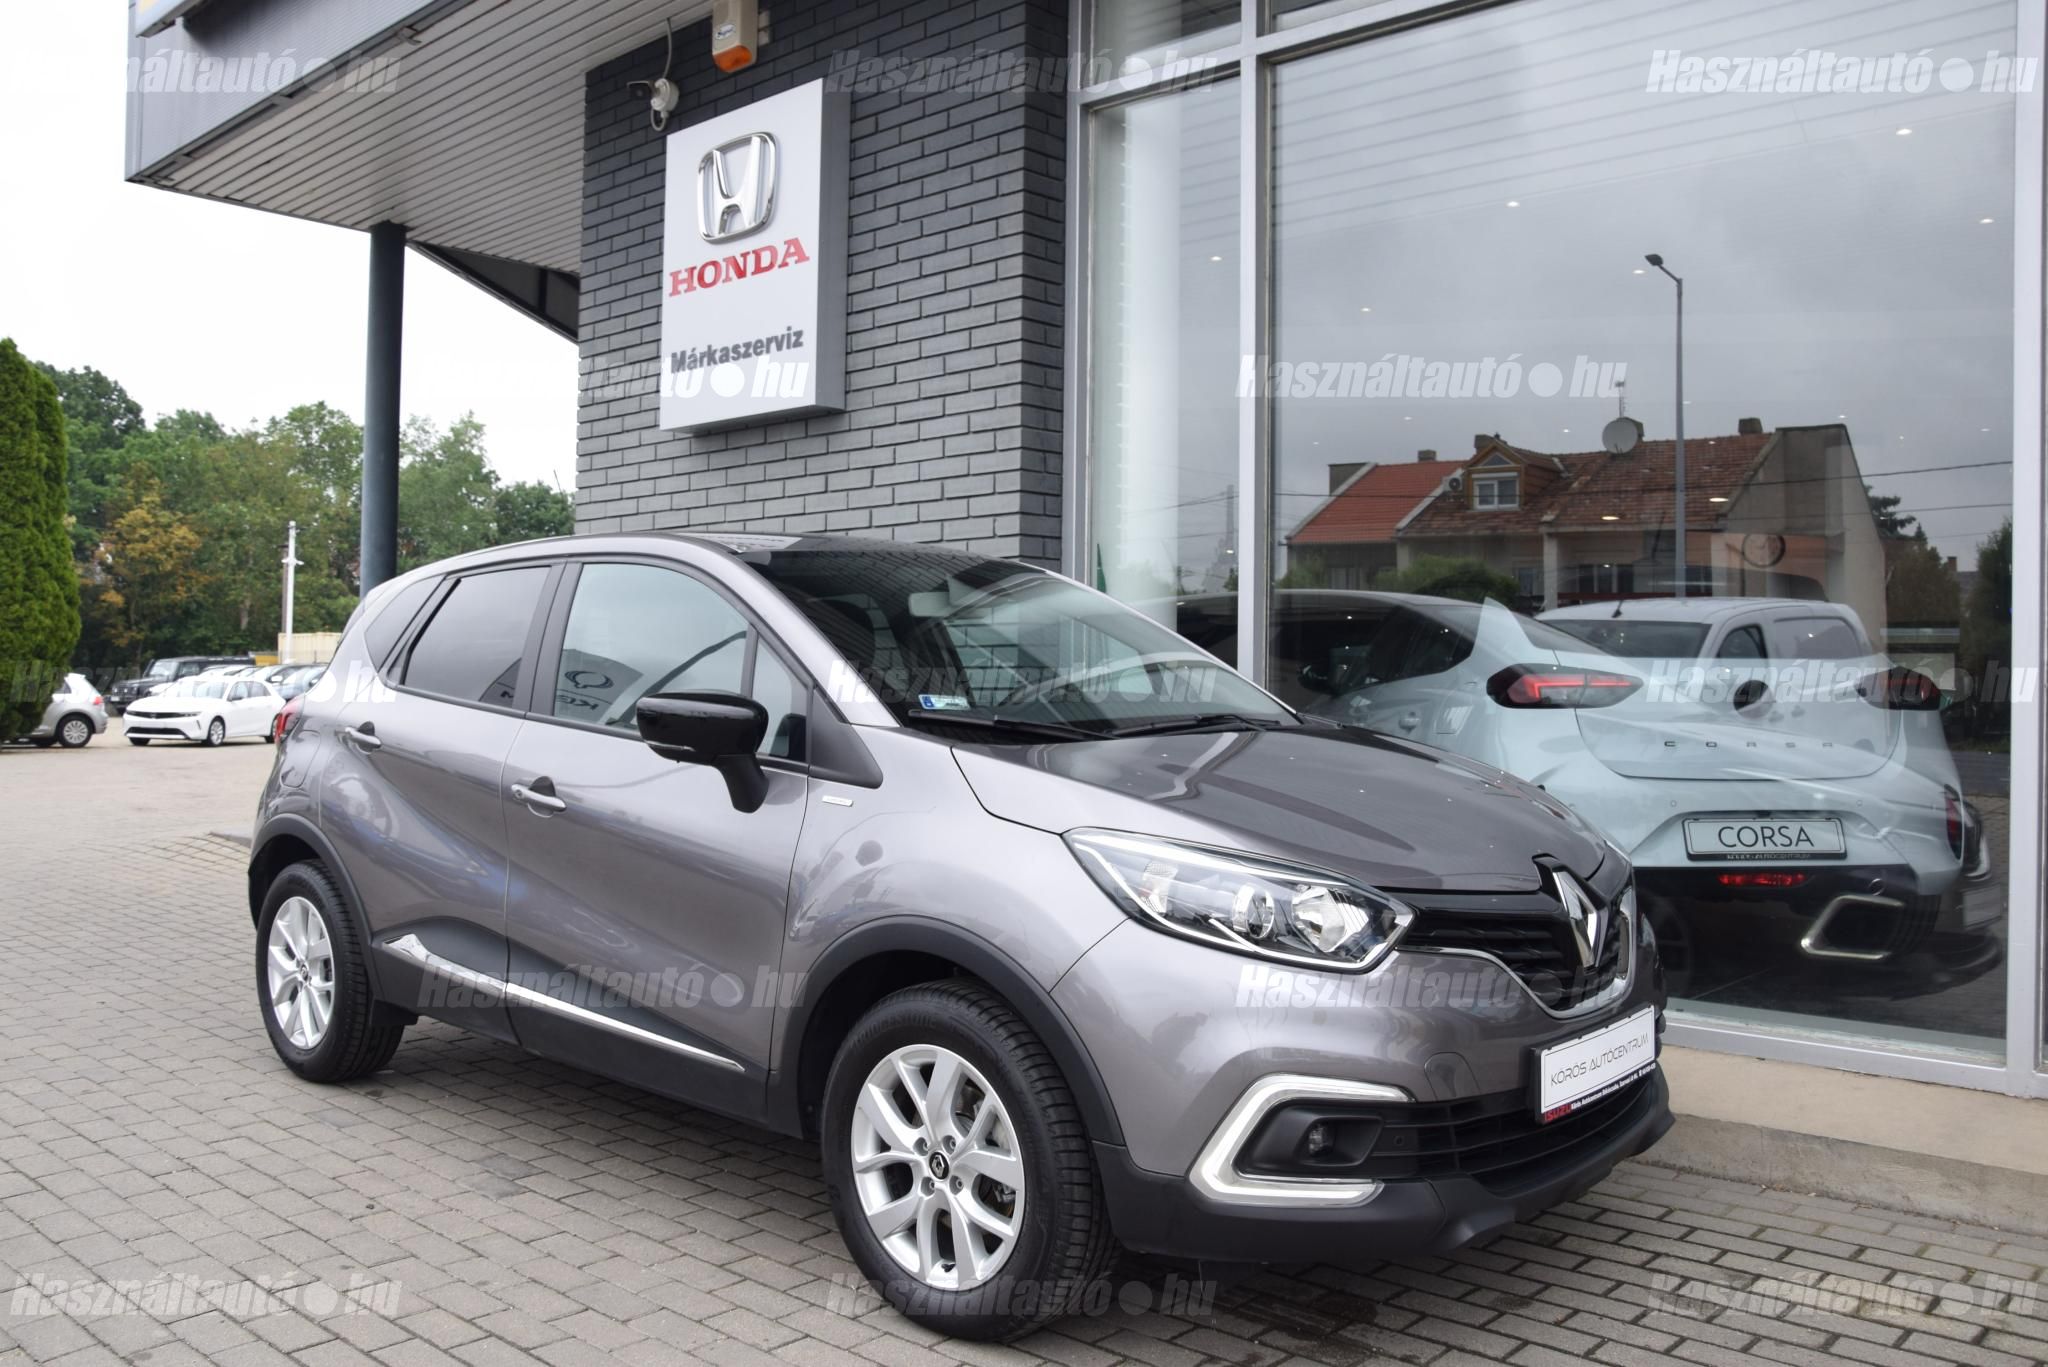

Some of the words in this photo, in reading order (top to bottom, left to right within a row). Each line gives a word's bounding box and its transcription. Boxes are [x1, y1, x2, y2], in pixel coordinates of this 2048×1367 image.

[669, 237, 810, 297] HONDA
[671, 325, 804, 374] Márkaszerviz
[1718, 825, 1814, 848] CORSA
[1544, 1103, 1572, 1123] ISUZU
